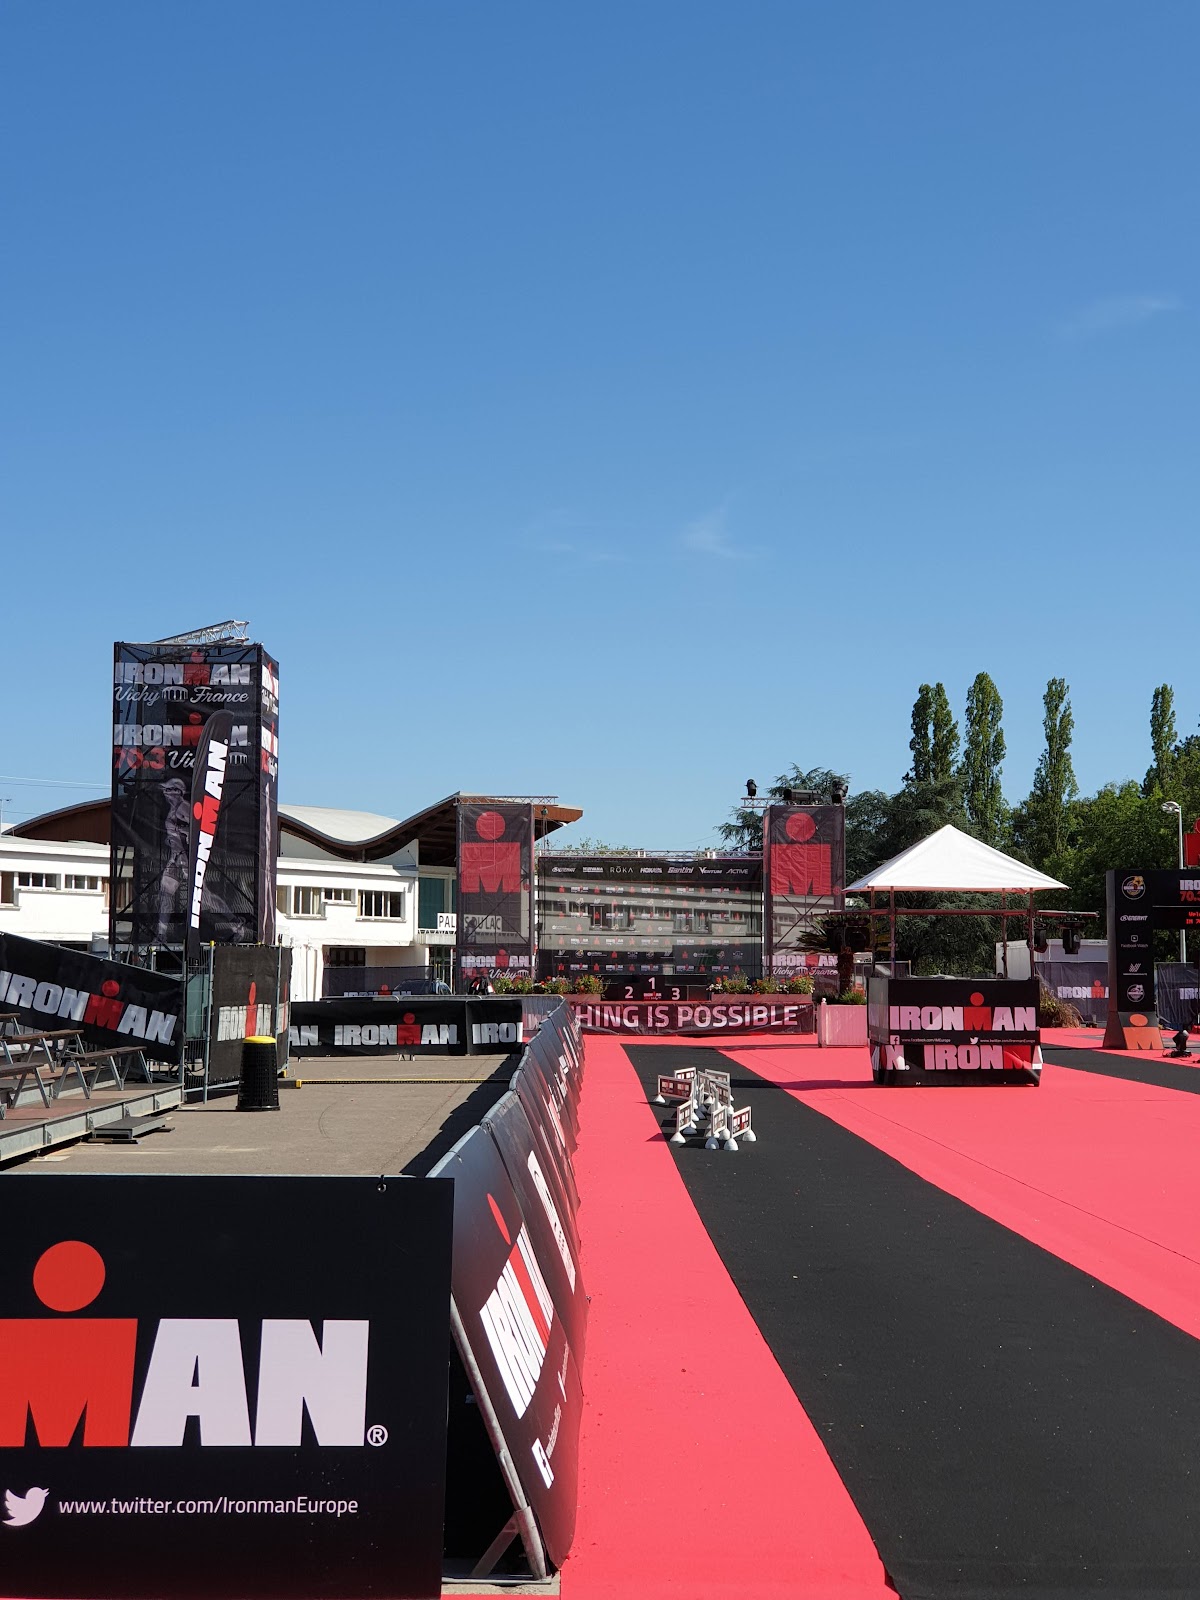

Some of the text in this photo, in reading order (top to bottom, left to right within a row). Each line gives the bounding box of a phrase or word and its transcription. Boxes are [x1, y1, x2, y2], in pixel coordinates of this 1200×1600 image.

[114, 663, 251, 686] IRONMAN
[114, 685, 160, 706] Vichy
[190, 686, 249, 704] France
[114, 724, 249, 747] IRONMN
[114, 747, 166, 770] 70.3
[191, 739, 228, 929] IRONMAN
[439, 915, 469, 929] PALS
[485, 917, 501, 930] LAC
[461, 955, 530, 968] IRONMAN
[773, 966, 795, 976] Vichy
[624, 986, 634, 999] 2
[647, 976, 656, 990] 1
[671, 987, 681, 1000] 3
[647, 1005, 670, 1028] IS
[677, 1005, 799, 1028] POSSIBLE
[889, 1005, 1036, 1031] IRONMAN
[333, 1023, 457, 1046] IRONMAN
[58, 1495, 360, 1518] www.twitter.com/IronmanEurope
